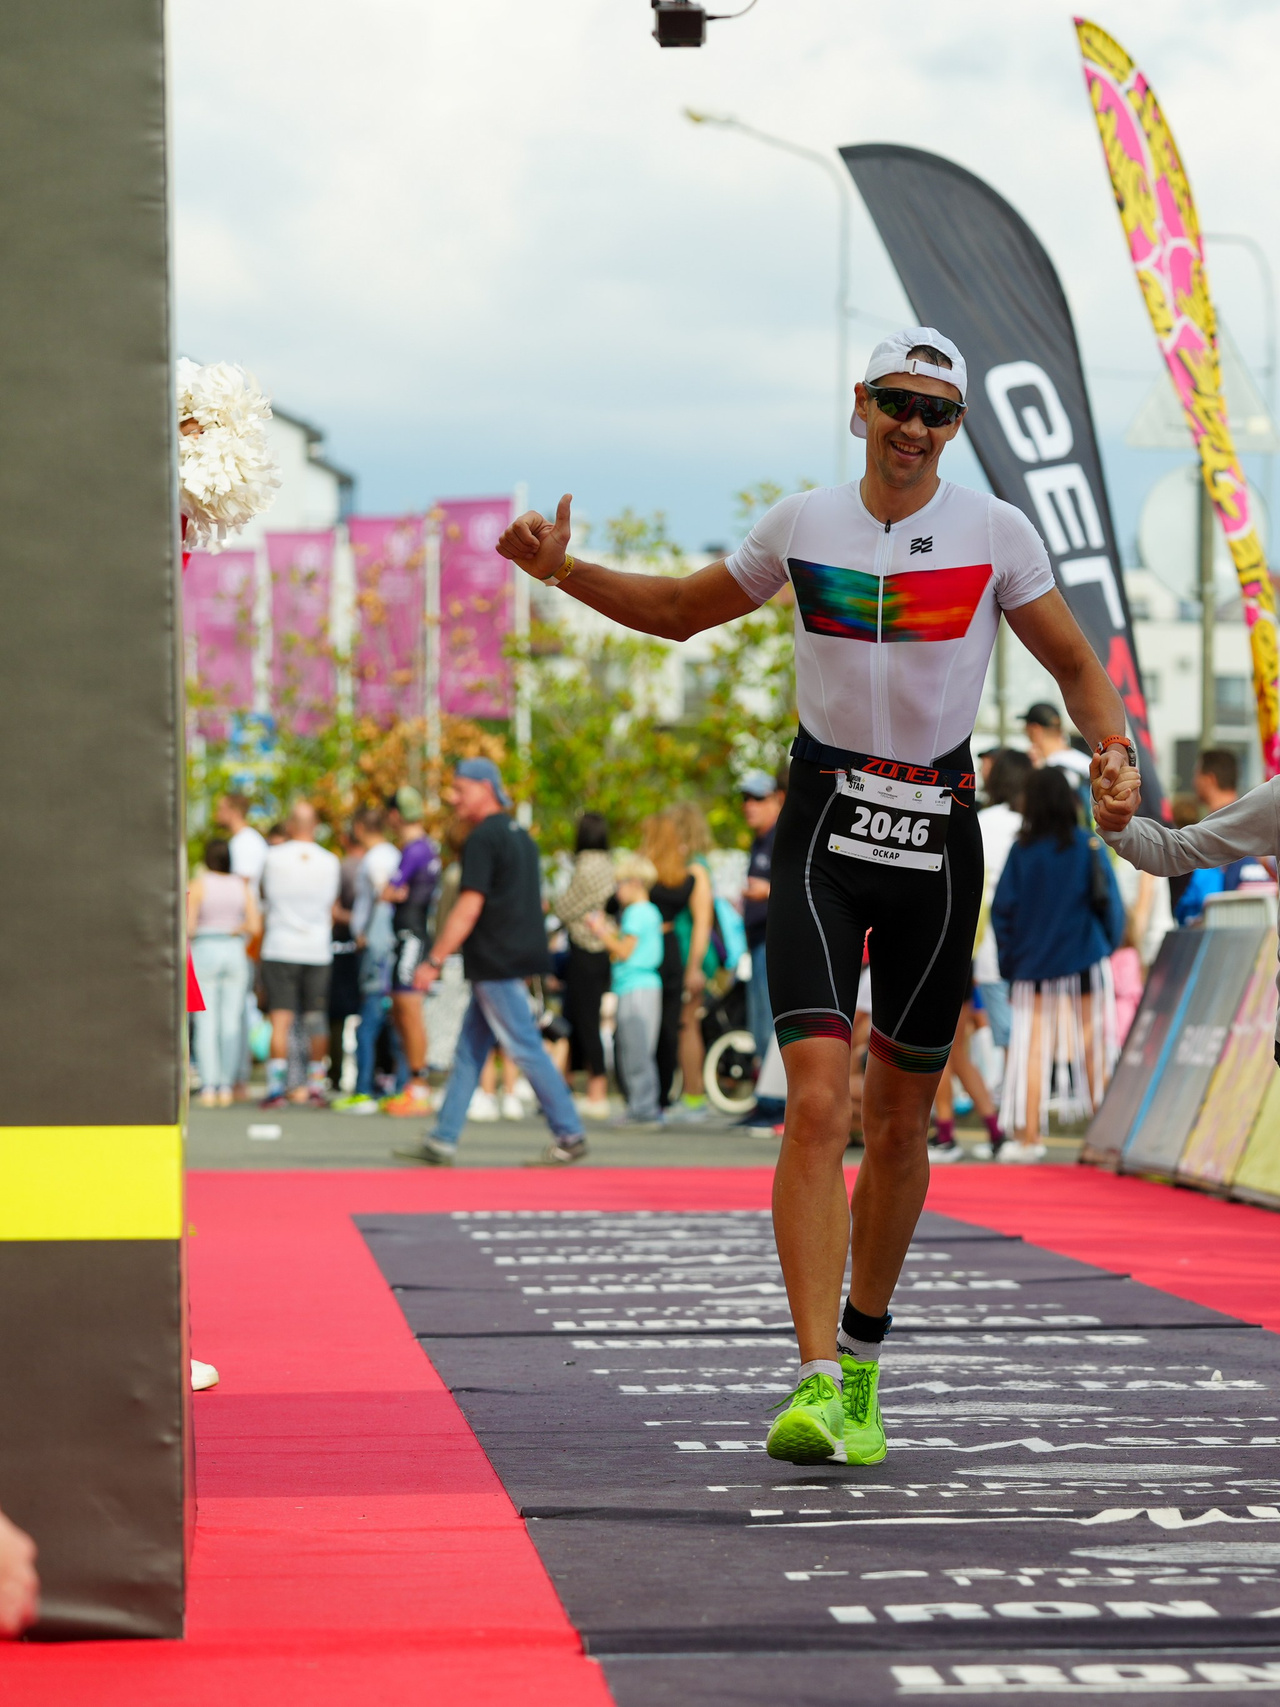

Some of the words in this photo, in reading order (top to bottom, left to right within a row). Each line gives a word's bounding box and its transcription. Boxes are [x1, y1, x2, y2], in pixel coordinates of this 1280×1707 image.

[861, 757, 939, 785] ZONE3
[848, 781, 865, 792] STAR
[850, 805, 930, 847] 2046
[872, 848, 900, 860] ОСКАР
[619, 1383, 794, 1393] IRO
[673, 1437, 959, 1449] IRN
[828, 1600, 1221, 1624] IRON
